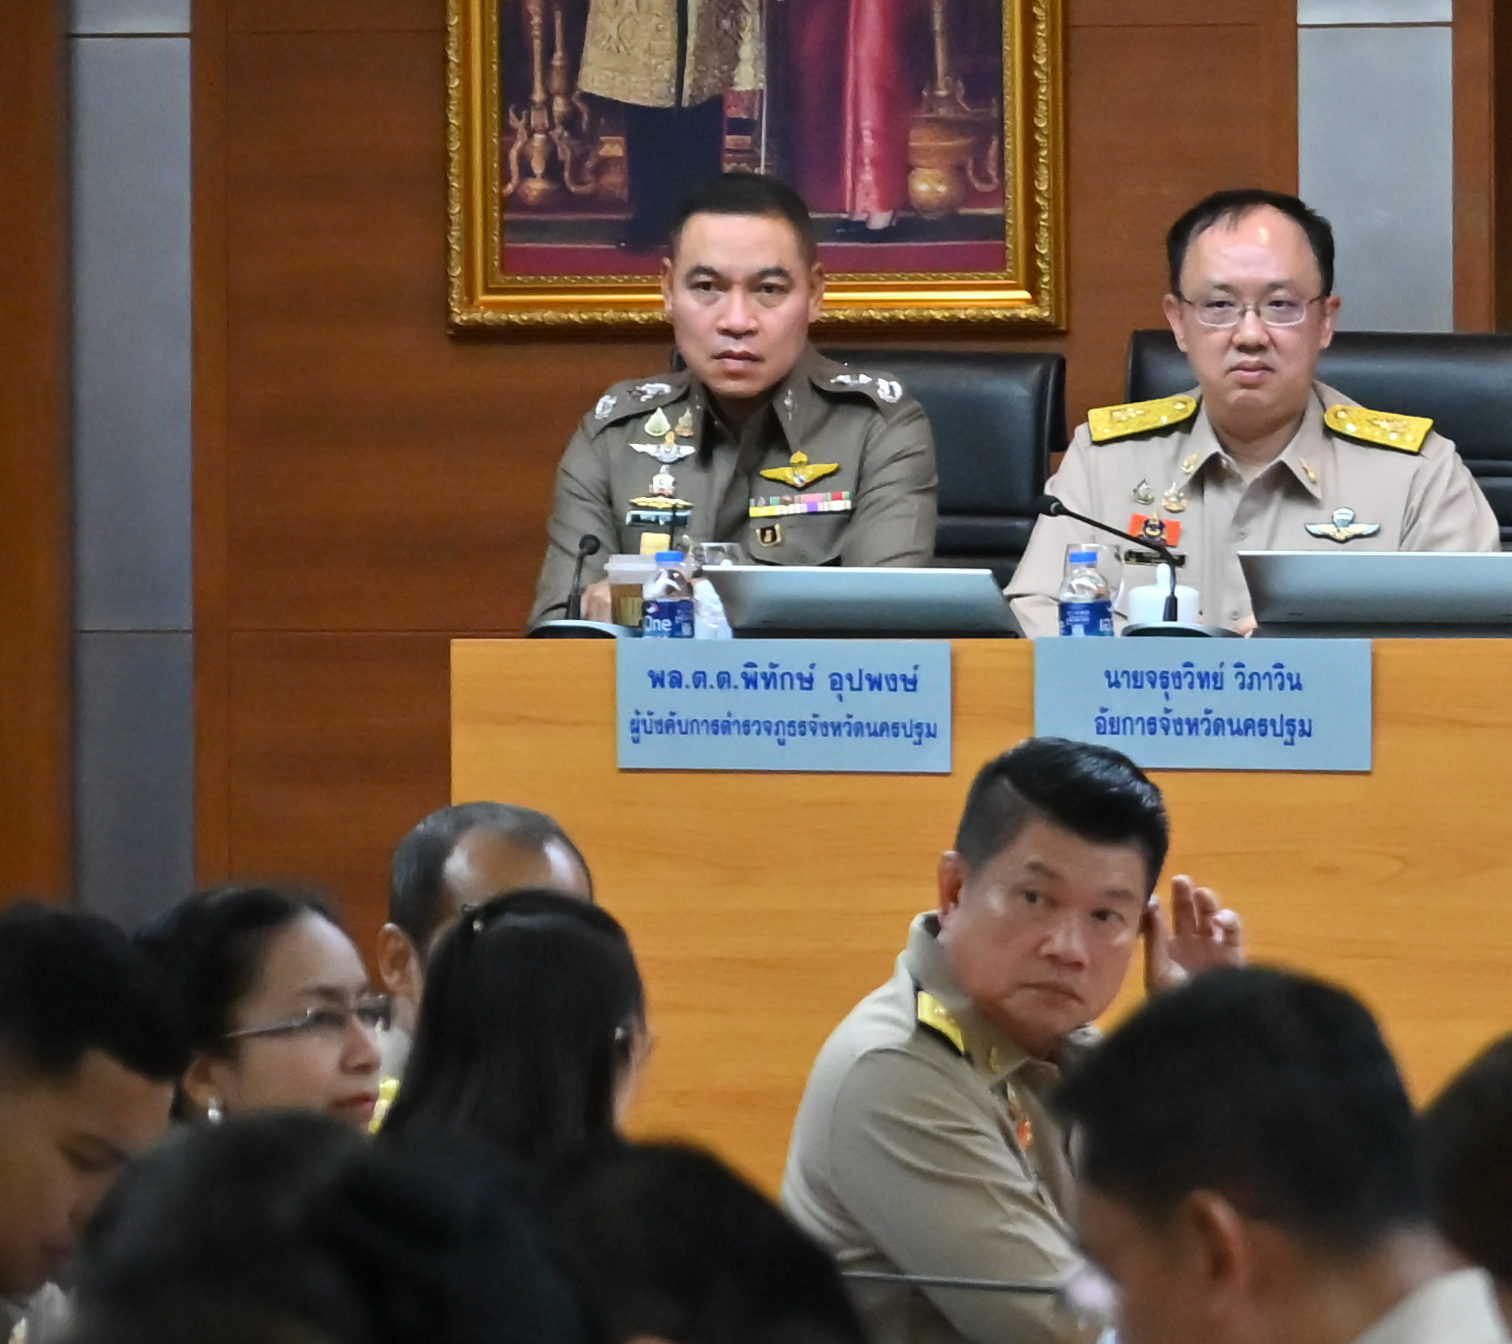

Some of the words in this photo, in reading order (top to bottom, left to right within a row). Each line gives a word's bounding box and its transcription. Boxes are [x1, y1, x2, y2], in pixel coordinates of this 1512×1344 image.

[828, 664, 920, 703] อุปพงษ์
[1093, 707, 1314, 747] อัยการจังหวัดนครปฐม
